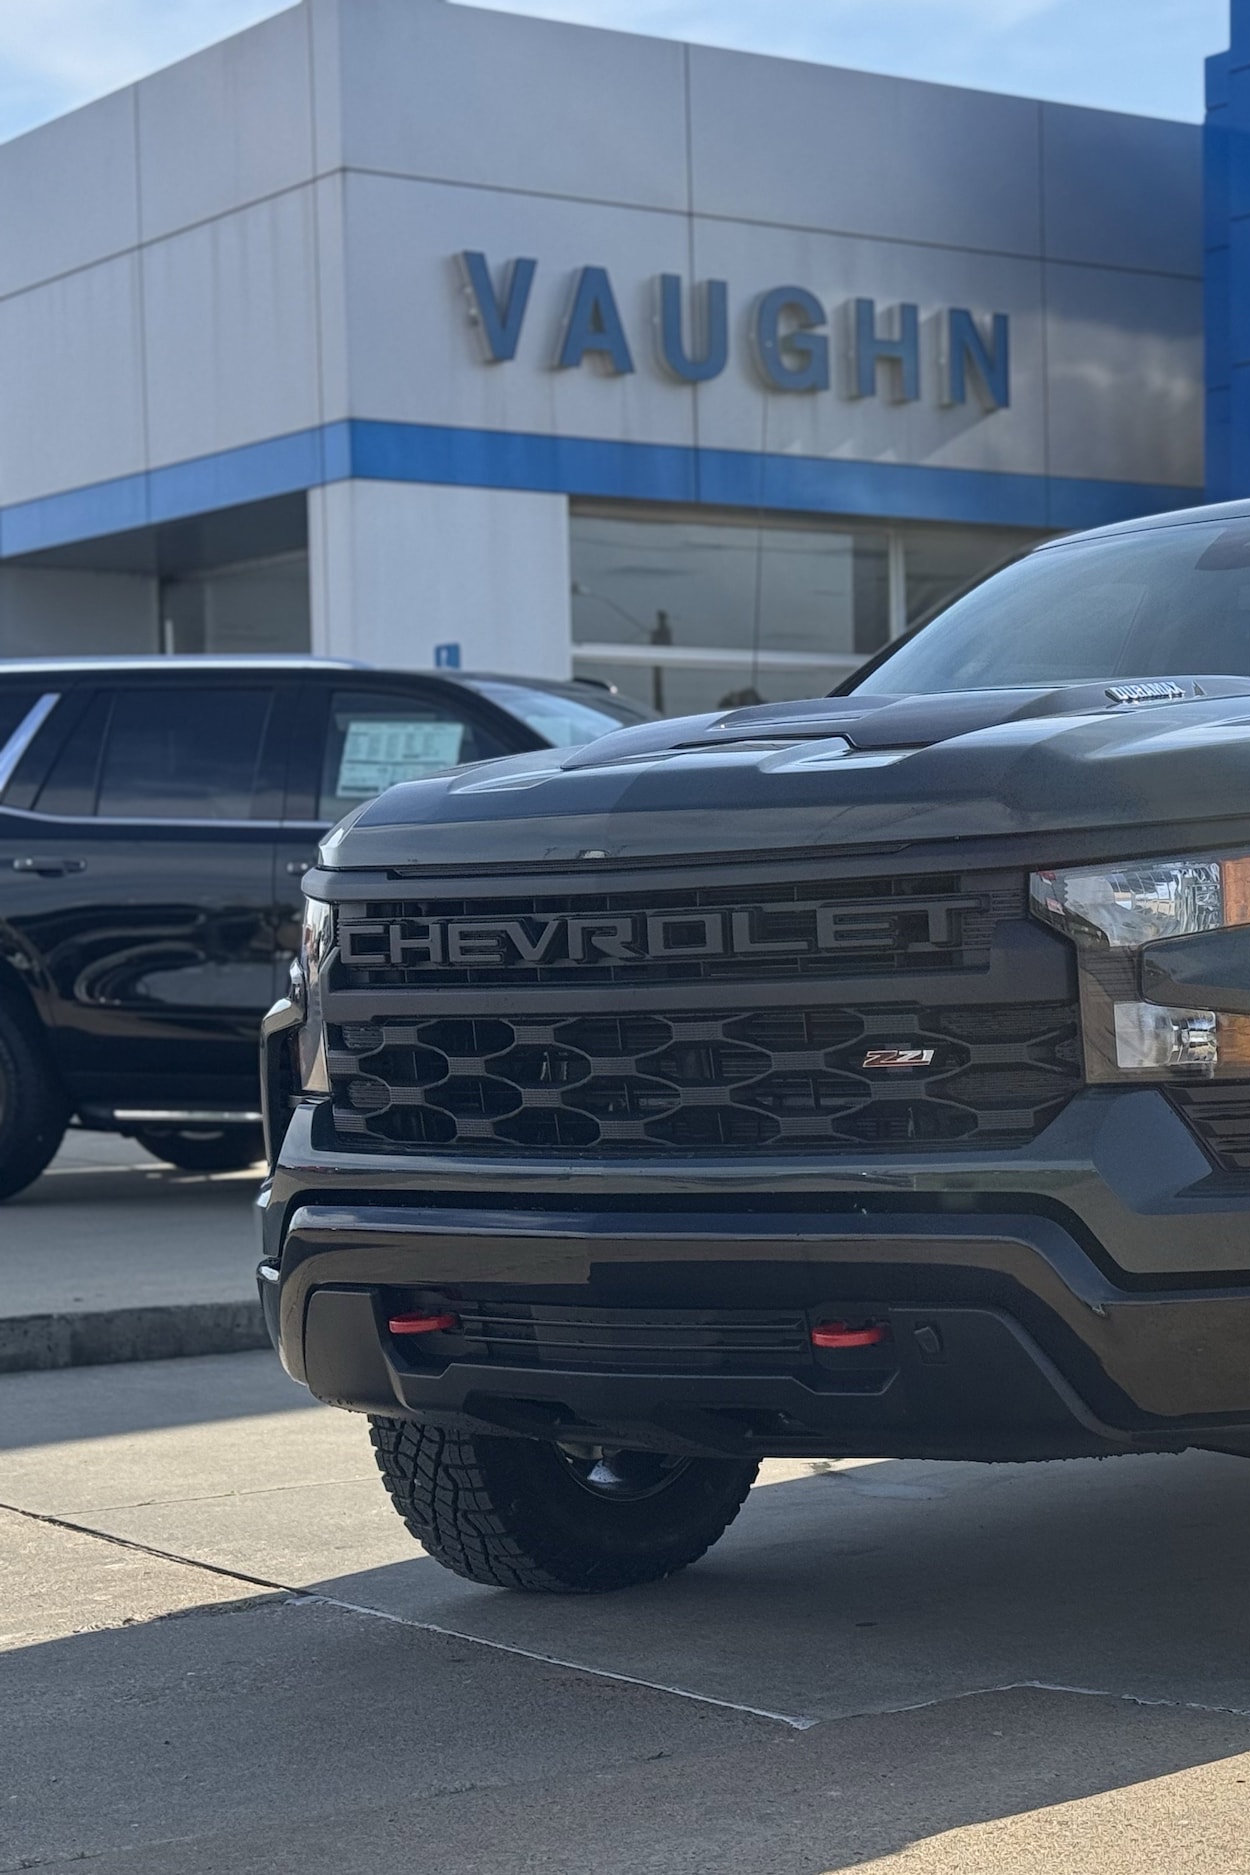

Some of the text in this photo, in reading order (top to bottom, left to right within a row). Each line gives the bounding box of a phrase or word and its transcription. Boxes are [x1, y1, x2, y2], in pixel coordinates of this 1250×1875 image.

[456, 249, 1010, 410] VAUGHN
[1106, 681, 1186, 702] DURAMAX
[339, 898, 986, 966] CHEVROLET
[862, 1049, 935, 1068] Z71
